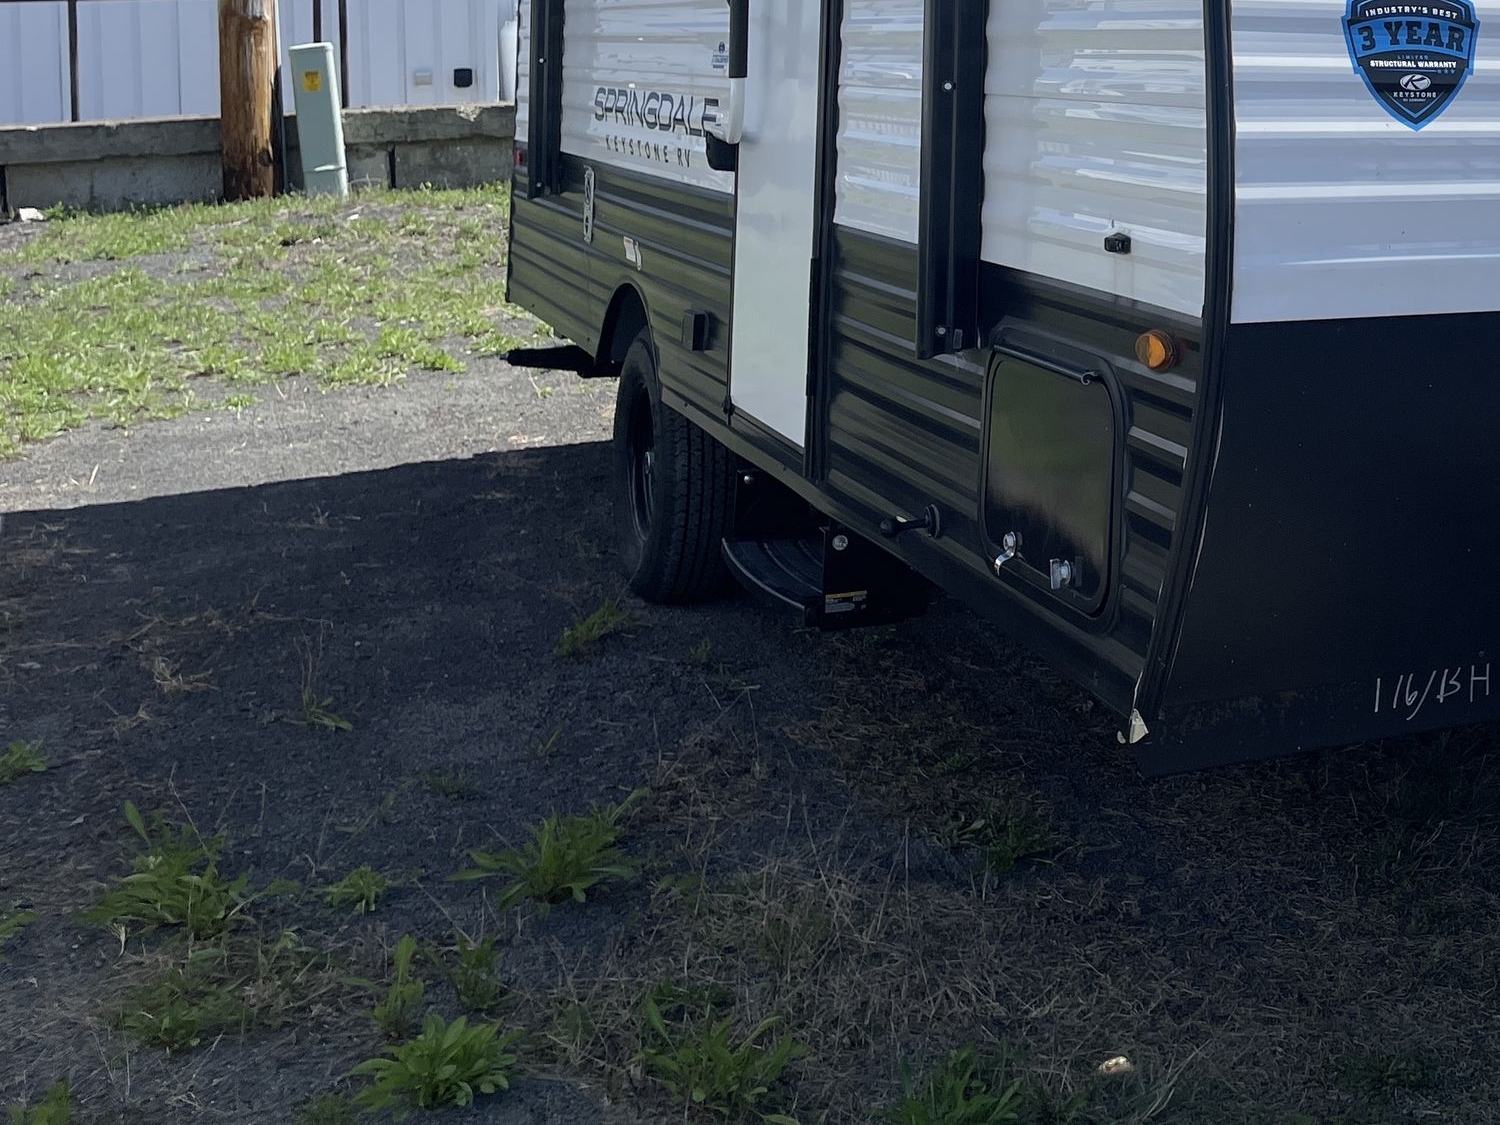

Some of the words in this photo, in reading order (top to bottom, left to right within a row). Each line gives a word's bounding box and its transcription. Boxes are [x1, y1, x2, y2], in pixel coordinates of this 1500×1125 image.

[1364, 5, 1428, 18] INDUSTRY'S
[1432, 7, 1458, 20] BEST
[1356, 25, 1377, 52] 3
[1382, 20, 1465, 53] YEAR
[1369, 59, 1417, 68] STRUCTURAL
[1417, 60, 1457, 69] WARRANTY
[1392, 91, 1437, 99] KEYSTONE
[593, 86, 721, 138] SPRINGDALE
[604, 133, 669, 164] KEYSTONE
[676, 147, 691, 168] RV
